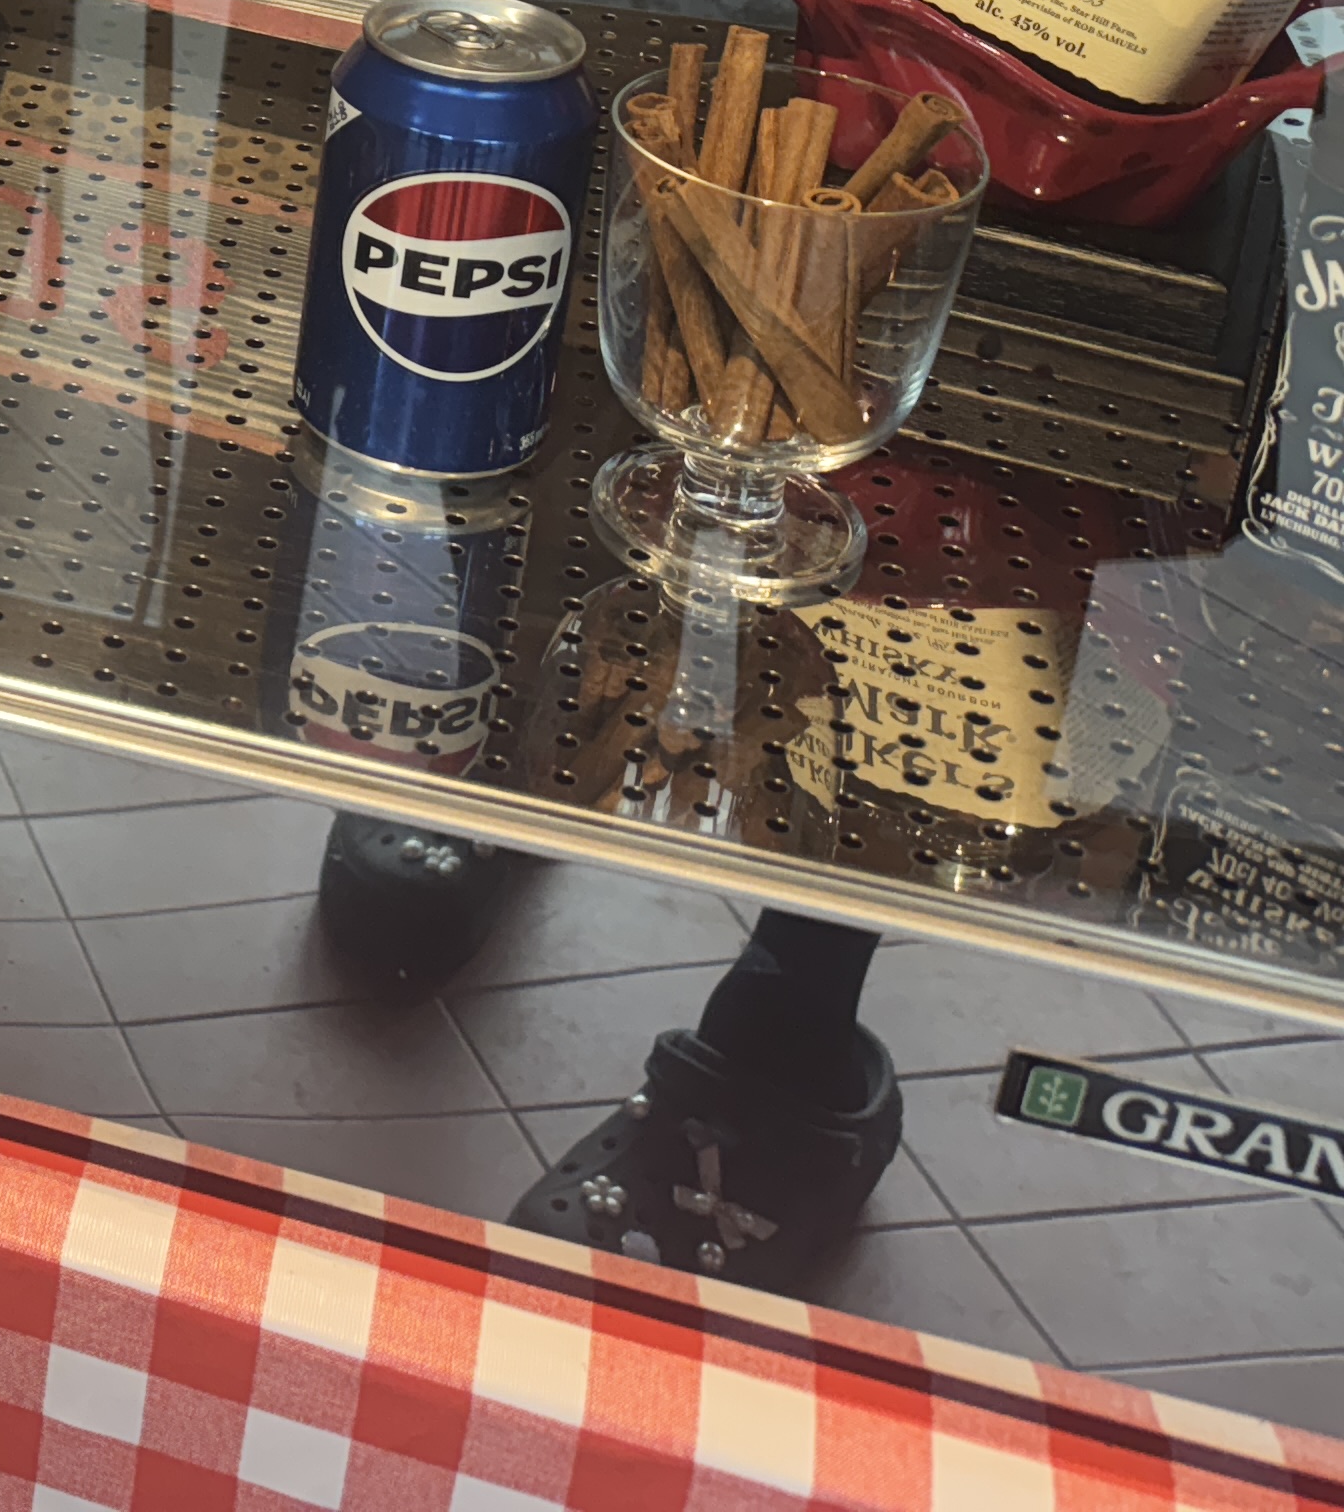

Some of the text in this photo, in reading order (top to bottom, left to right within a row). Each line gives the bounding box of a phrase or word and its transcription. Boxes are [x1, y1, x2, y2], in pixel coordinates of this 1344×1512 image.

[1010, 14, 1050, 41] 45%
[1056, 36, 1087, 59] vol.
[1062, 14, 1074, 25] of
[1074, 20, 1095, 34] ROB
[1096, 29, 1148, 55] SAMUELS
[1070, 4, 1090, 19] Star
[1091, 13, 1110, 28] Hill
[354, 230, 564, 298] PEPSI
[1312, 469, 1344, 503] 70
[1260, 493, 1309, 521] JACK
[1101, 1089, 1344, 1190] GRAN
